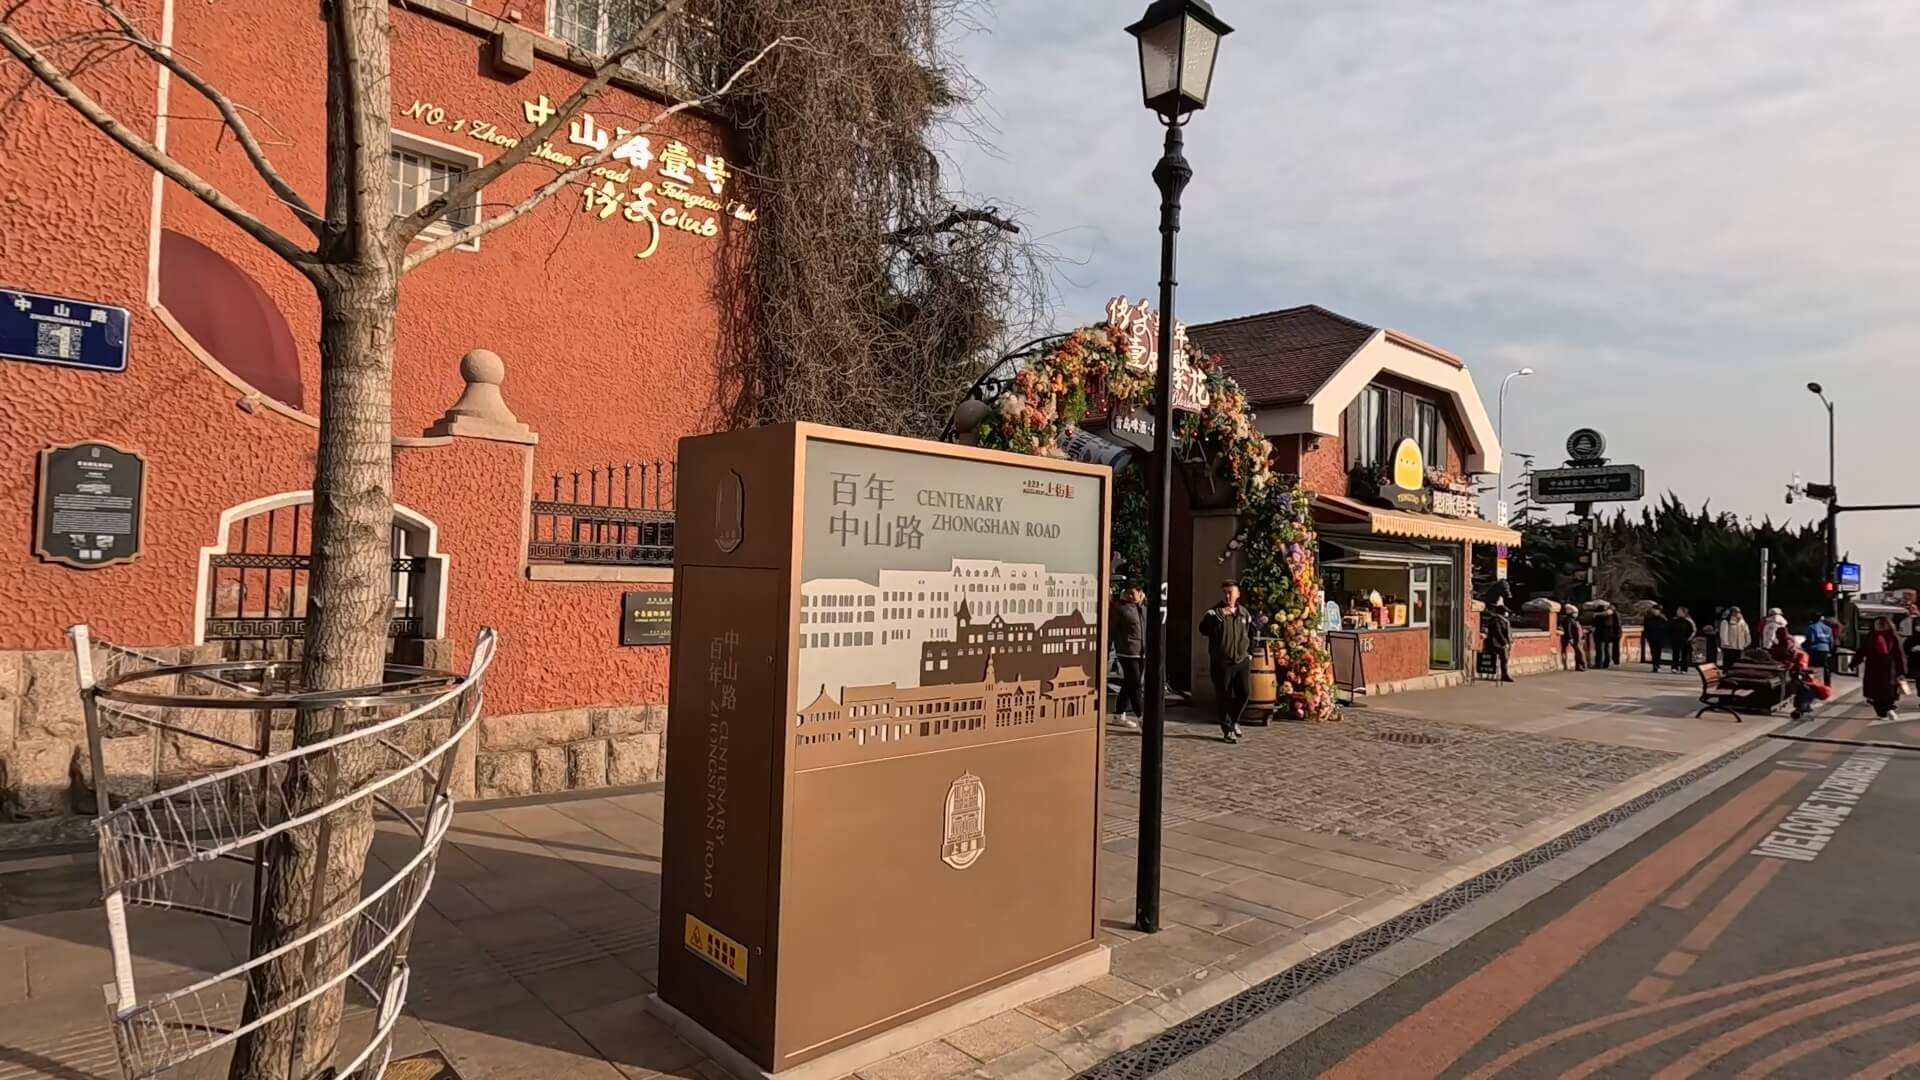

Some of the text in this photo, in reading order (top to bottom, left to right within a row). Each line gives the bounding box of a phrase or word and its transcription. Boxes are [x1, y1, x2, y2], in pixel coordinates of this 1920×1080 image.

[660, 207, 718, 237] Club
[829, 472, 895, 510] 百年
[916, 489, 1004, 513] CENTENARY
[829, 509, 925, 550] 中山路
[931, 513, 1061, 539] ZHONGSHAN ROAD
[707, 635, 724, 689] 百年
[721, 627, 740, 712] 中山路
[1749, 801, 1853, 862] WELCOME
[1806, 790, 1861, 806] TO
[703, 838, 716, 899] ROAD
